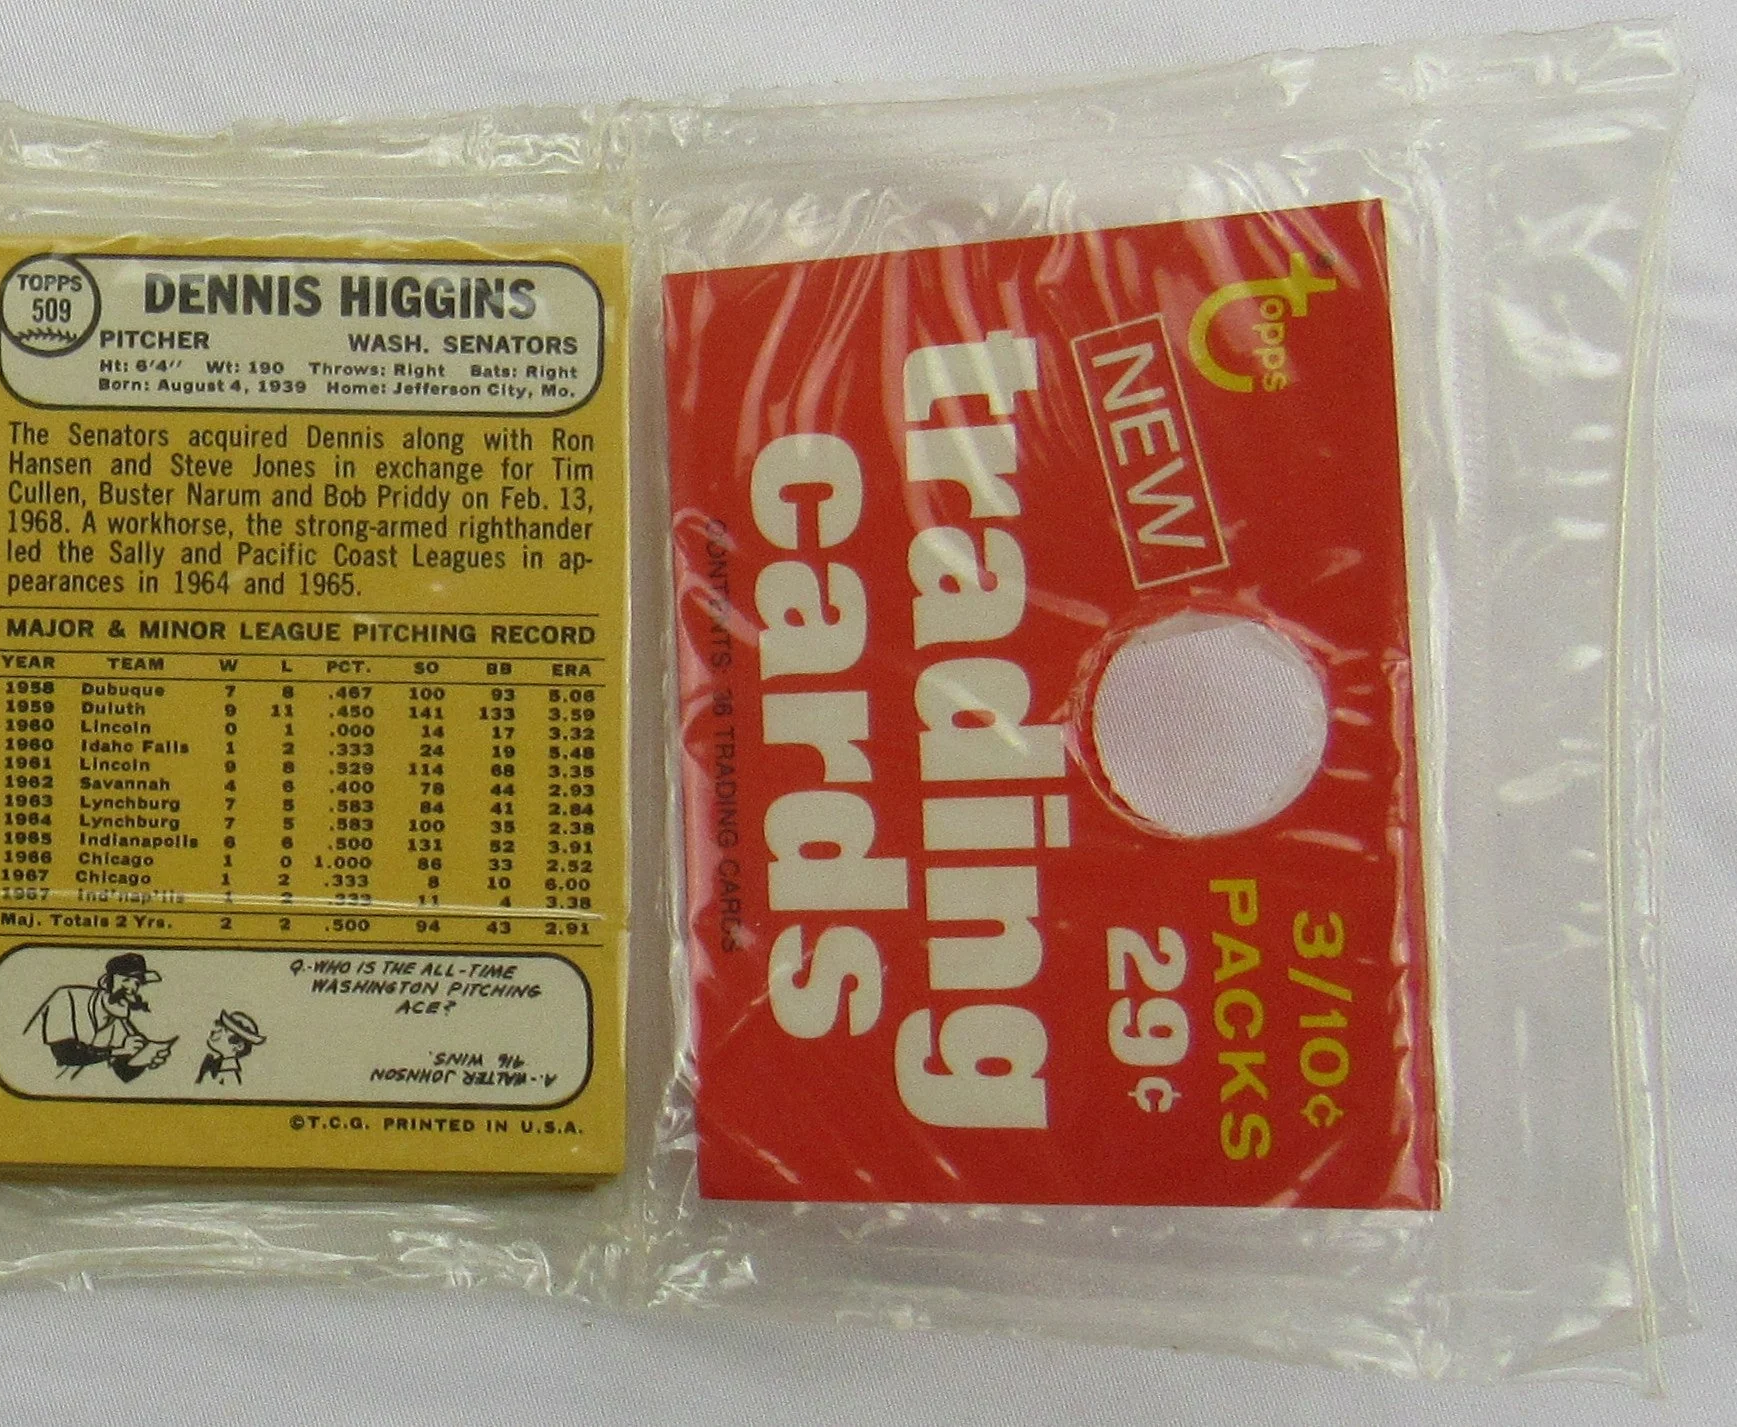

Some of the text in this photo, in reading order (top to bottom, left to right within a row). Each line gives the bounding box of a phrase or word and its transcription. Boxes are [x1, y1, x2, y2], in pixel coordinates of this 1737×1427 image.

[16, 273, 83, 293] TOPPS
[144, 272, 536, 320] DENNIS HIGGINS
[32, 297, 72, 324] 509
[1188, 251, 1338, 393] topps
[99, 329, 210, 350] PITCHER
[347, 333, 578, 356] WASH. SENATORS
[157, 378, 225, 395] August
[258, 379, 307, 394] 1939
[392, 380, 481, 397] Jefferson
[486, 382, 533, 400] City,
[541, 383, 575, 398] Mo.
[8, 420, 595, 457] The Senators acquired Dennis along with Ron
[1092, 342, 1206, 548] NEW
[8, 479, 593, 515] Cullen, Buster Narum and Bob Priddy on Feb. 13,
[8, 508, 594, 545] 1968. A workhorse, the strong-armed righthander
[1, 654, 592, 678] YEAR TEAM W L PCT. SO BB ERA
[81, 681, 166, 699] Dubuque
[224, 684, 236, 699] 7
[409, 686, 446, 702] 100
[749, 433, 909, 1039] cards
[894, 330, 1071, 1130] trading
[715, 726, 738, 848] TRADING
[718, 859, 741, 952] CARDS
[1106, 926, 1189, 1113] 29¢
[1209, 878, 1272, 1160] PACKS
[383, 1115, 475, 1133] PRINTED
[486, 1119, 508, 1133] IN
[520, 1119, 584, 1136] U.S.A.
